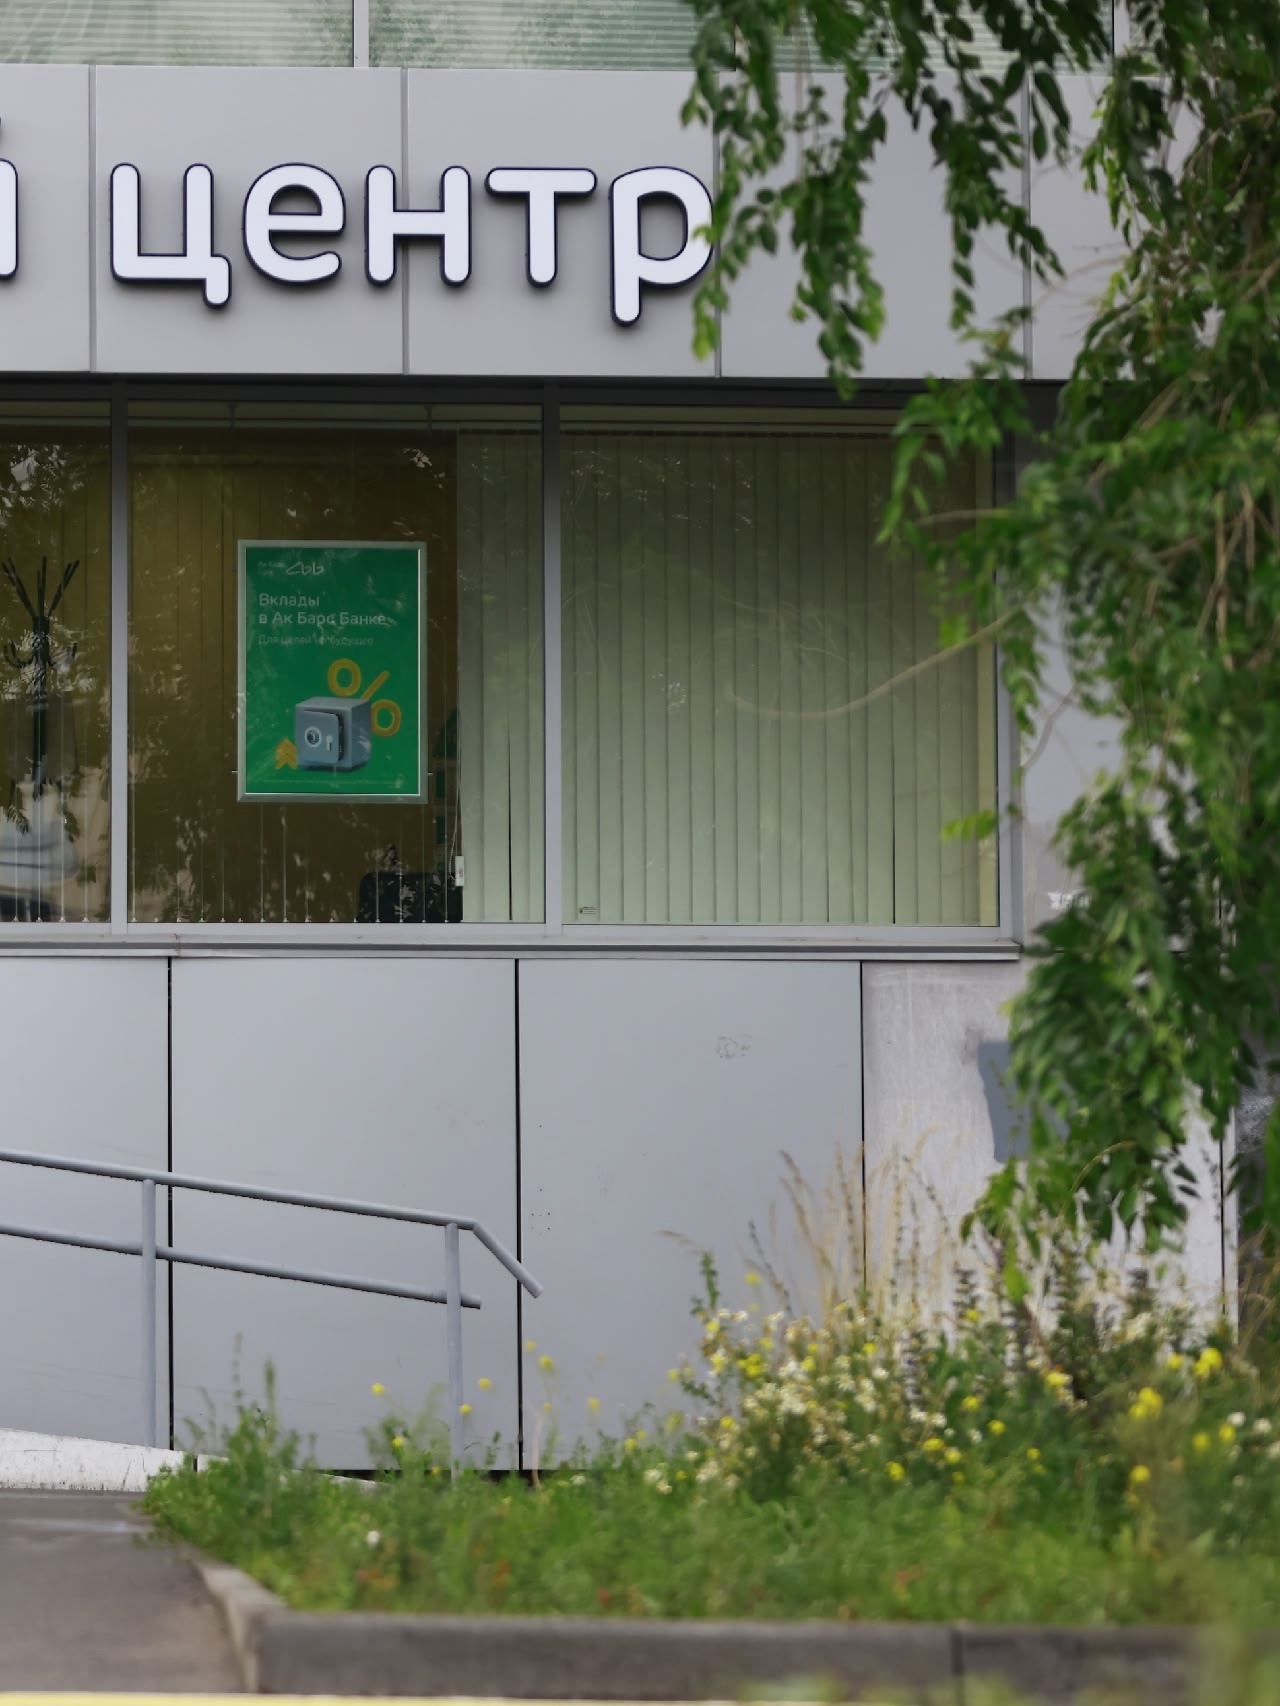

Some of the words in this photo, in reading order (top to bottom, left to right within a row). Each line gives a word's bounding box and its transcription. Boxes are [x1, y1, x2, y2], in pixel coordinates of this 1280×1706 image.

[110, 161, 713, 327] центр
[258, 592, 320, 608] Вклады
[258, 613, 268, 624] в
[271, 611, 293, 625] Ак
[297, 611, 336, 628] Барс
[339, 611, 387, 626] Банке
